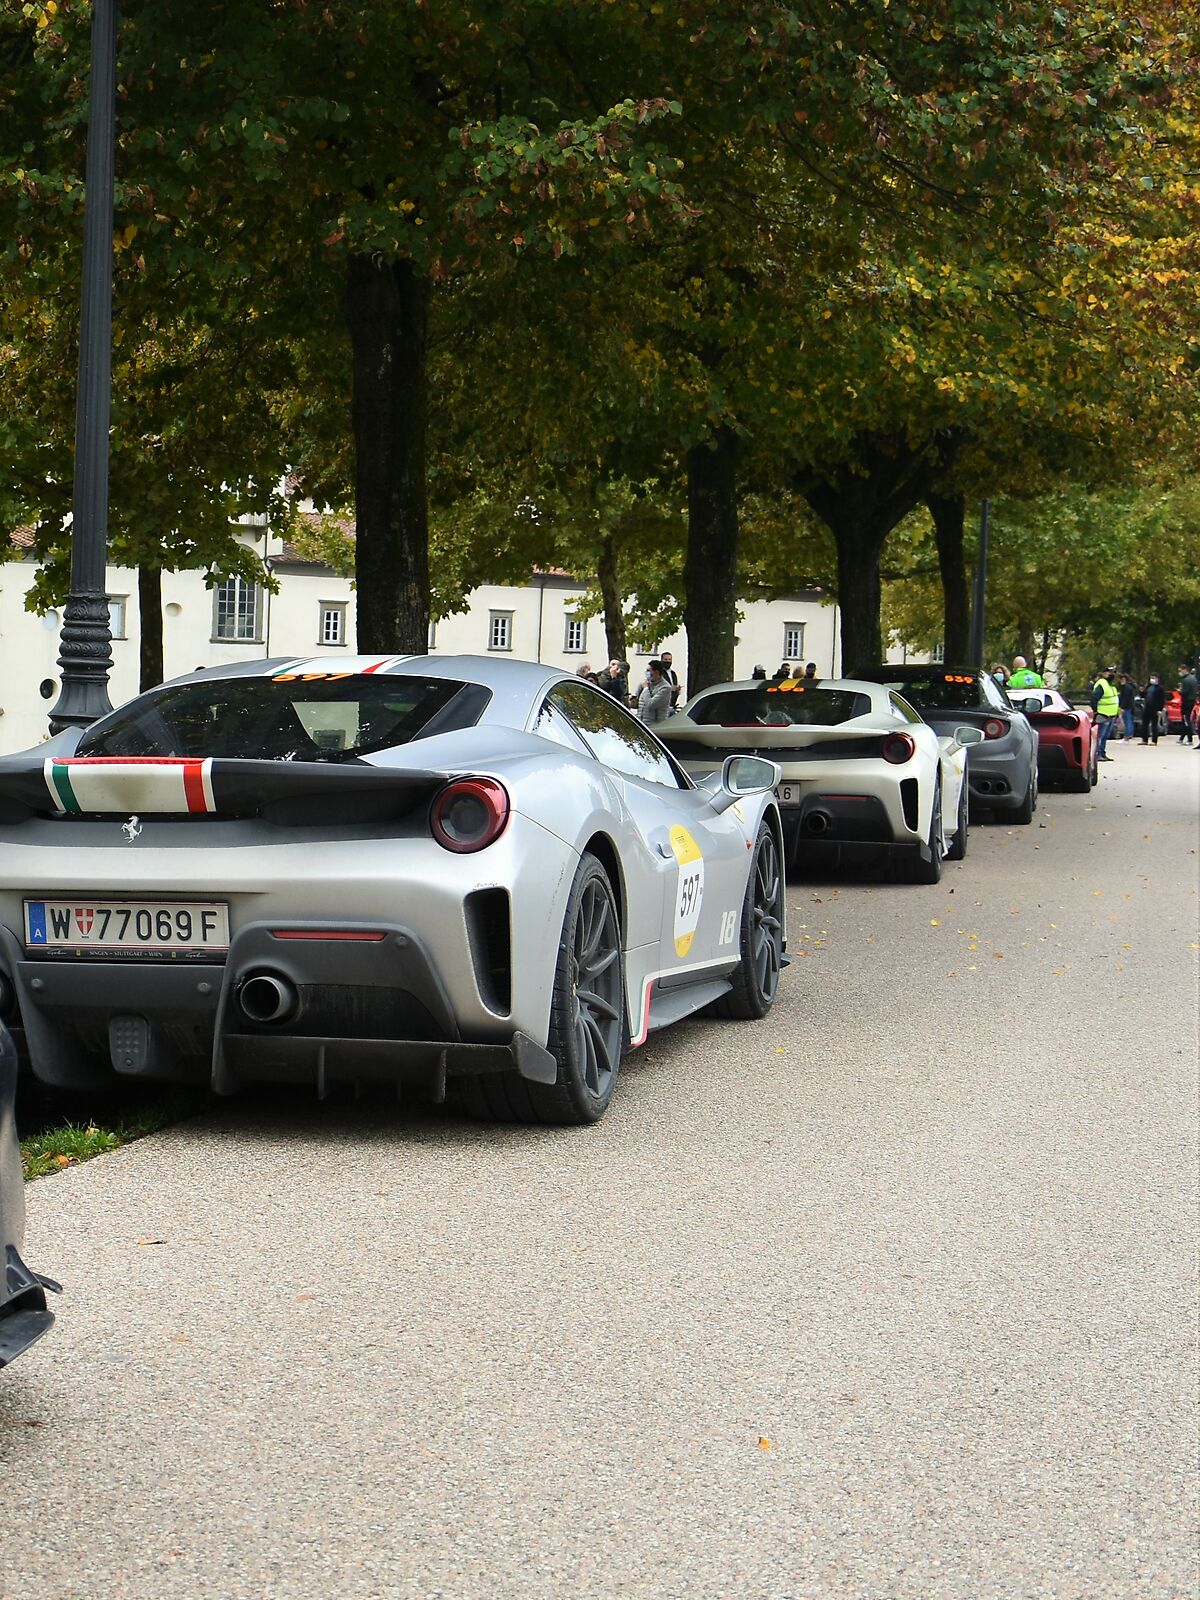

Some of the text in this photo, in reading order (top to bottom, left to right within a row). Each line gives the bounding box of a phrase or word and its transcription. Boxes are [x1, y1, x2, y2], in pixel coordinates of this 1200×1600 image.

[783, 787, 792, 800] 6
[680, 874, 700, 917] 597
[34, 928, 43, 938] A
[50, 908, 218, 942] W 77069 F
[718, 910, 737, 946] 18
